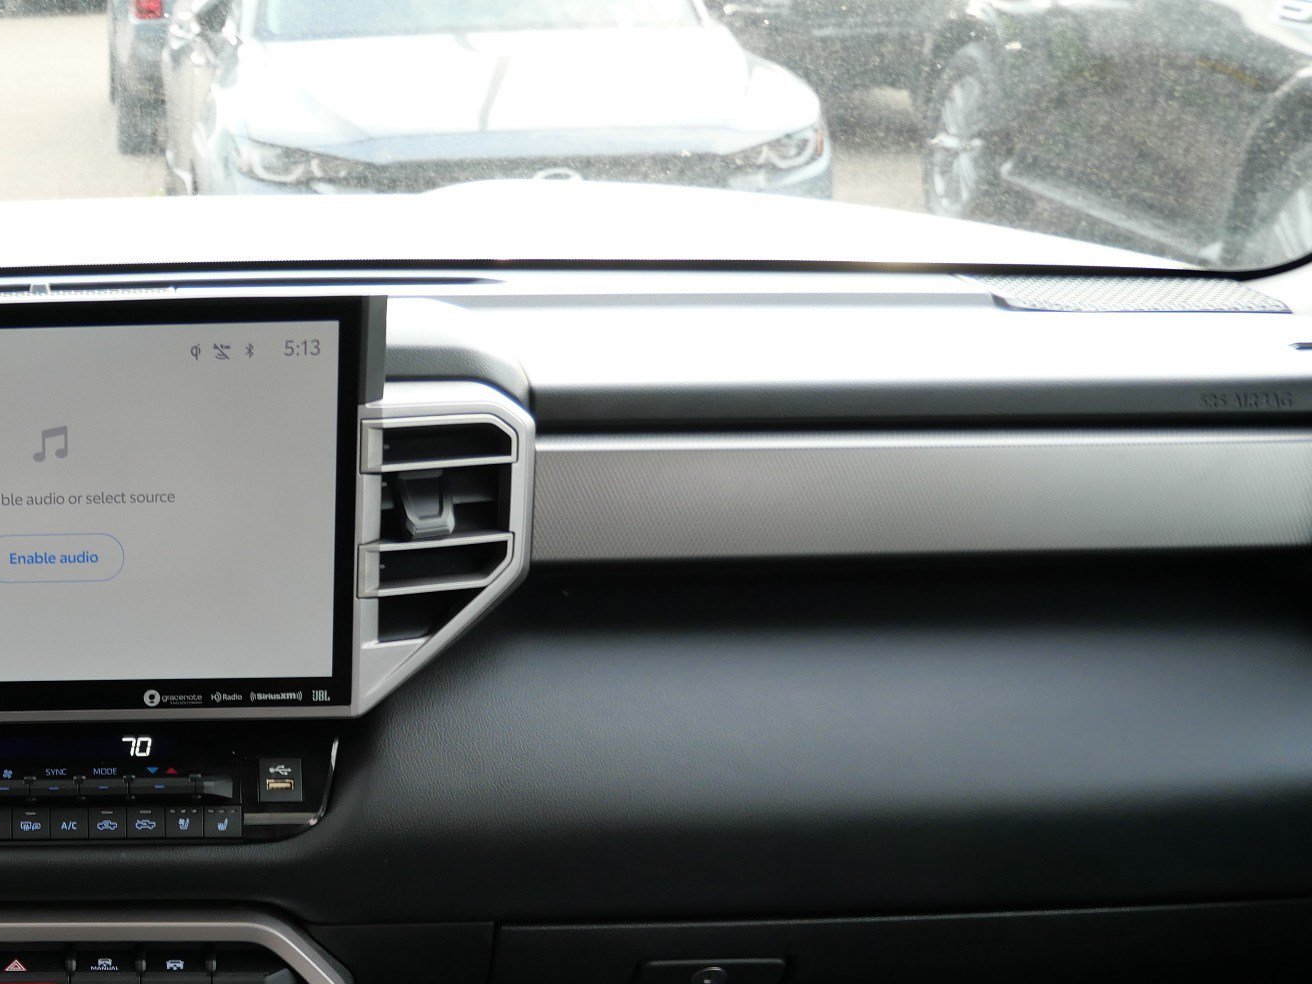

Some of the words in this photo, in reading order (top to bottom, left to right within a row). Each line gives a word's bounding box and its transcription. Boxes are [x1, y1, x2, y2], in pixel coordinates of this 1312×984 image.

[284, 339, 320, 356] 5:13
[26, 492, 65, 506] audio
[68, 495, 82, 505] or
[85, 490, 126, 504] select
[129, 492, 176, 504] source
[9, 551, 56, 565] Enable
[59, 550, 99, 564] audio
[312, 689, 331, 702] JBL
[122, 737, 152, 757] 70
[45, 767, 67, 776] SYNC
[93, 767, 118, 776] MODE
[61, 820, 77, 831] A/C
